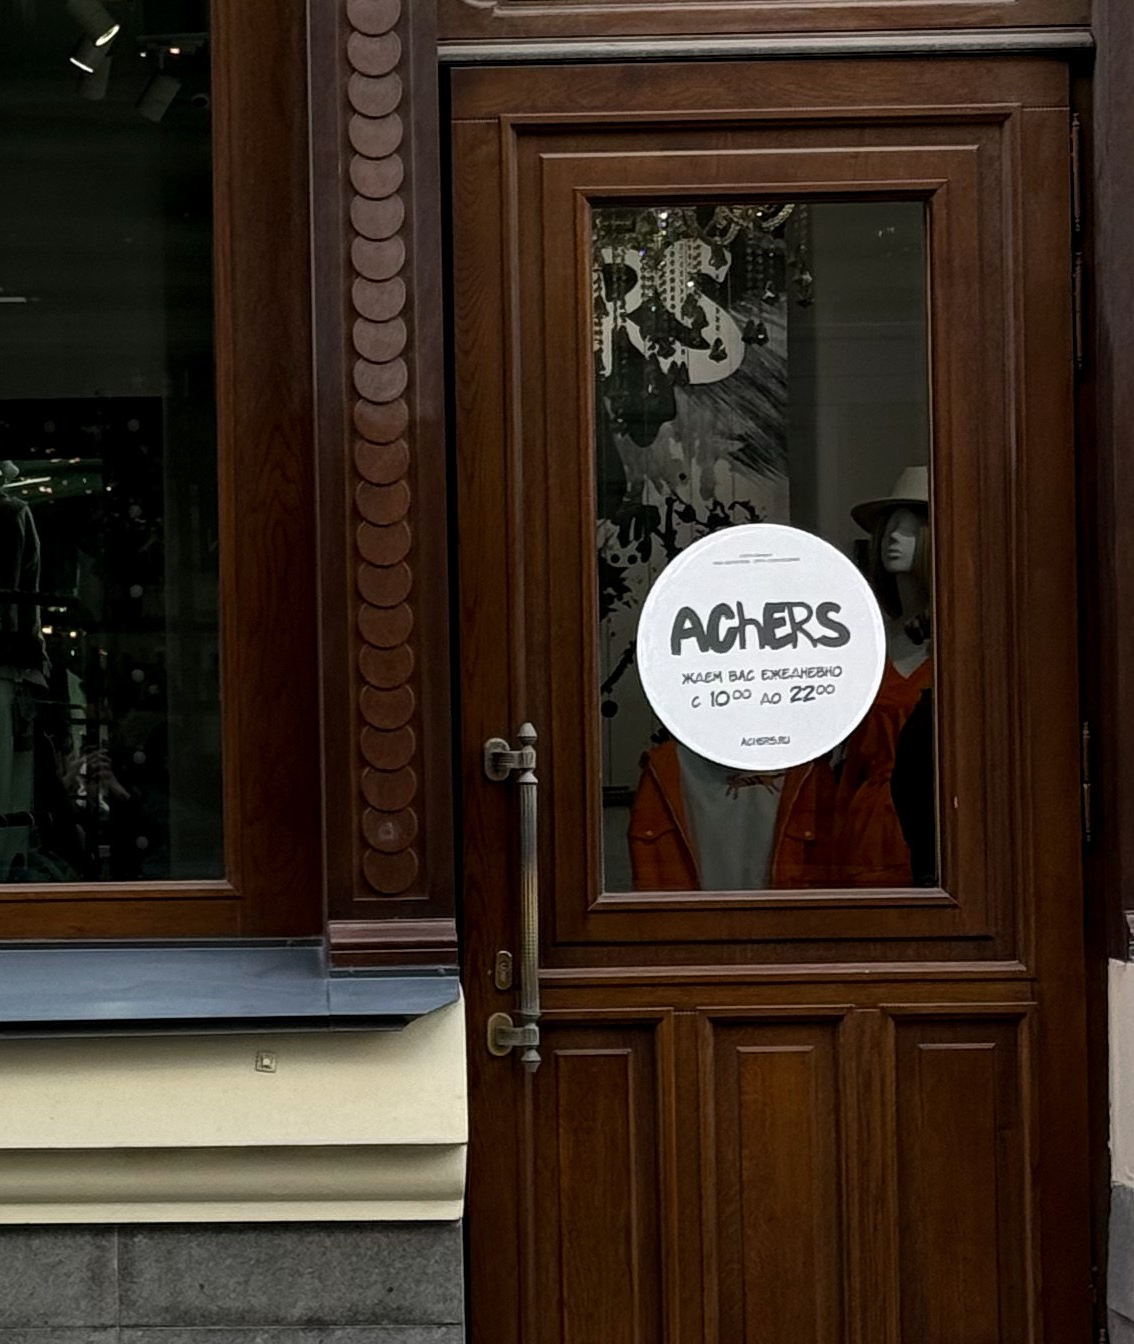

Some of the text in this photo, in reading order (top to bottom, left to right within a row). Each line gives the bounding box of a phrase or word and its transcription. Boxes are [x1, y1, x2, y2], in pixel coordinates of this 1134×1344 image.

[681, 665, 843, 685] ЖДЕМ ВАС ЕЖЕДНЕВНО
[759, 692, 782, 706] ДО
